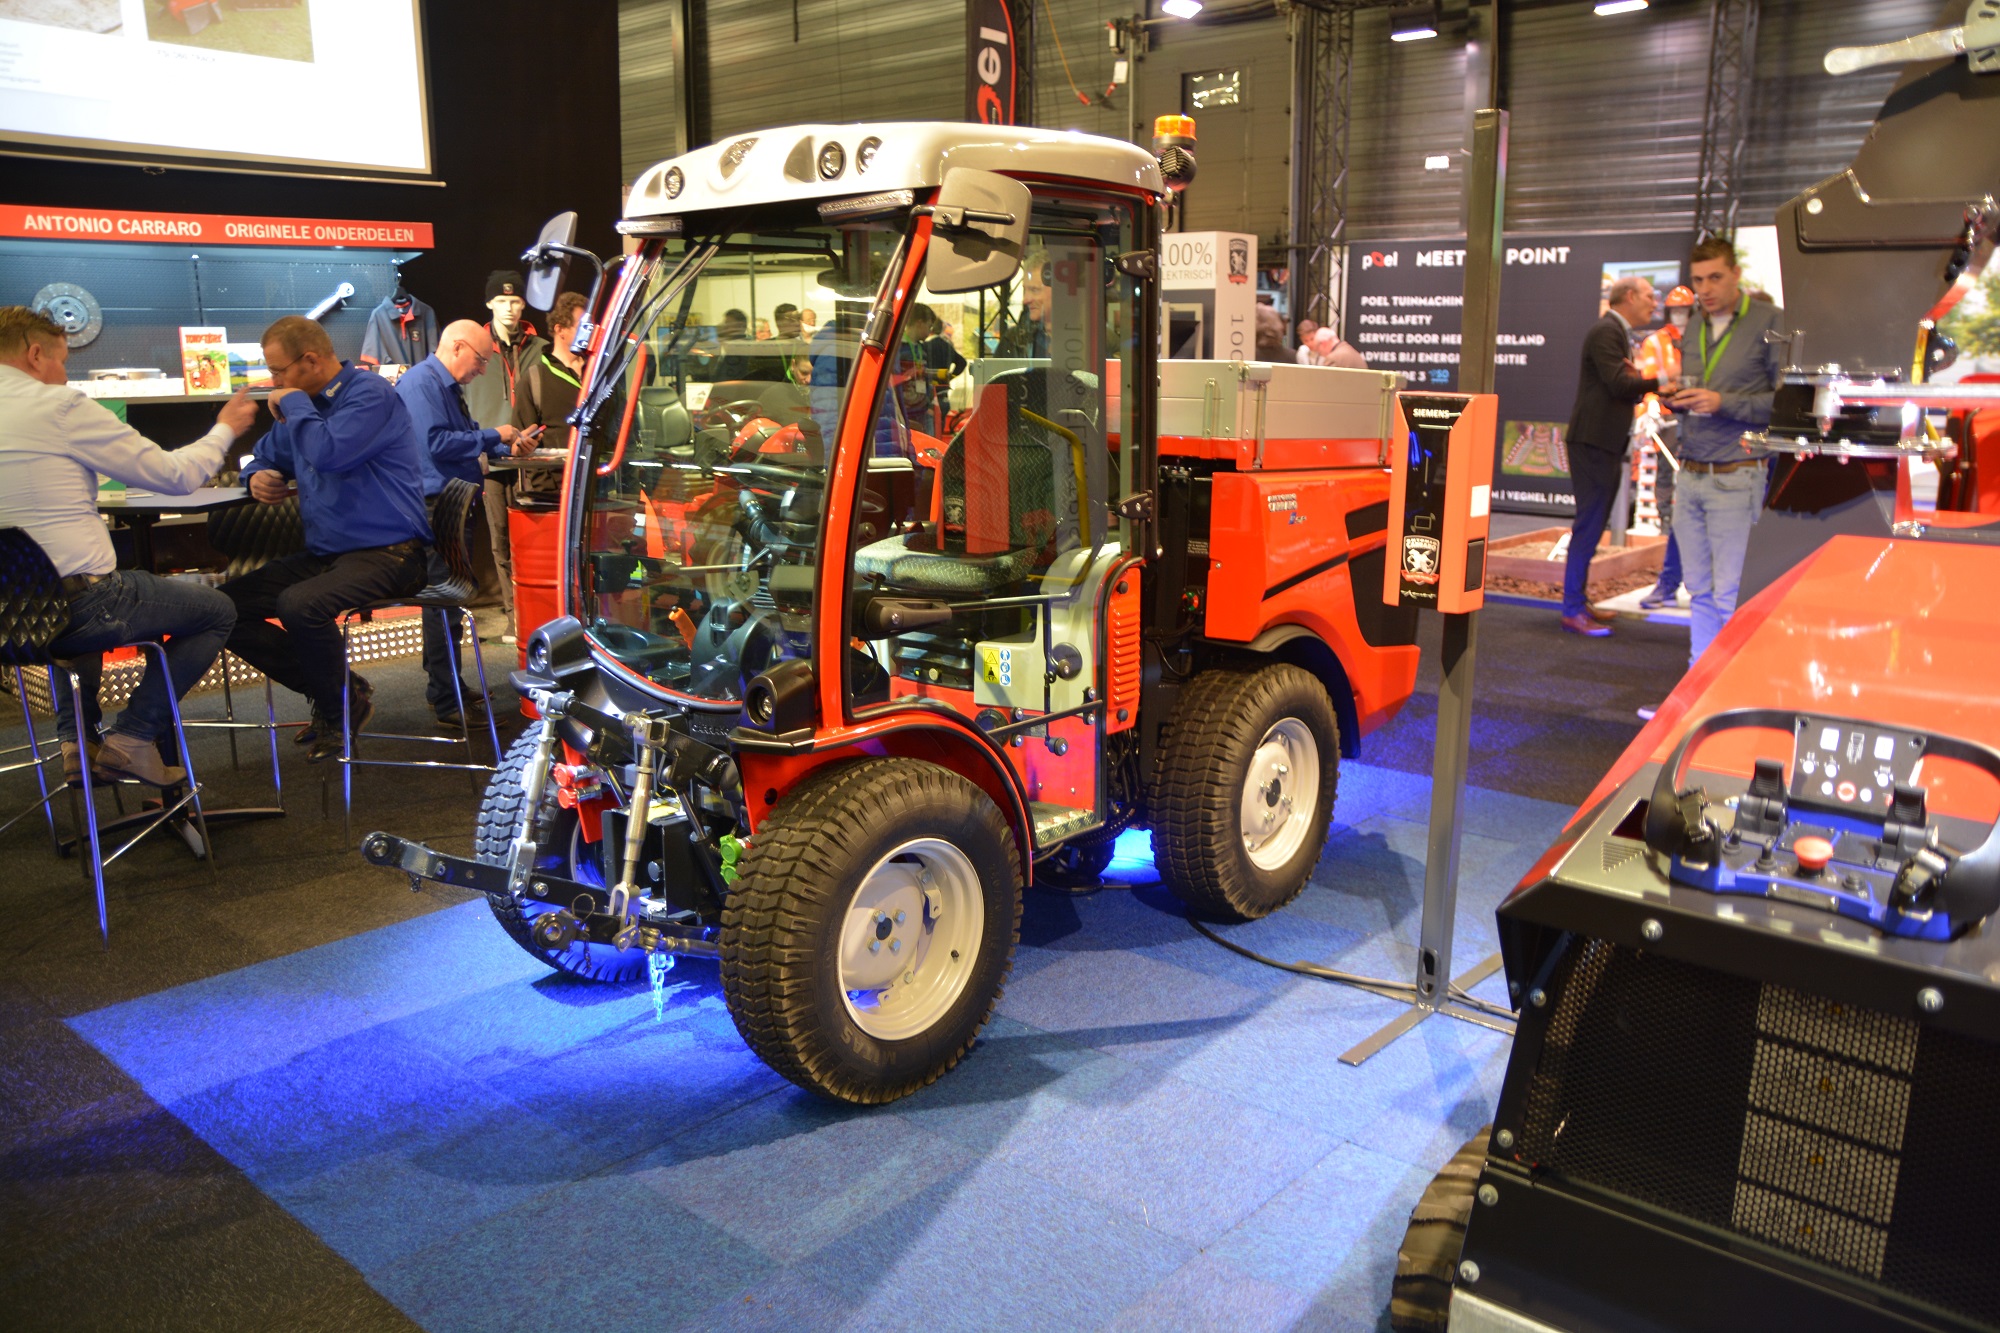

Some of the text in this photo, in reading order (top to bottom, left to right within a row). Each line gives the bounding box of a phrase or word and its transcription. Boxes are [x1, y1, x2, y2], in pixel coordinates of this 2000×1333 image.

[977, 26, 1008, 126] oel
[24, 213, 415, 243] ANTONIO CARRARO ORIGINELE ONDERDELEN
[1162, 242, 1213, 266] 00%
[1362, 247, 1570, 270] poel MEET POINT
[1162, 269, 1213, 280] LEKTRISCH
[1361, 296, 1464, 307] POEL TUINMACHIN
[1360, 314, 1433, 326] POEL SAFETY
[1358, 333, 1546, 346] SERVICE DOOR HEE ERLAND
[1398, 352, 1416, 363] BIJ
[1413, 408, 1450, 419] SIEMENS
[1506, 490, 1547, 503] VEGHEL
